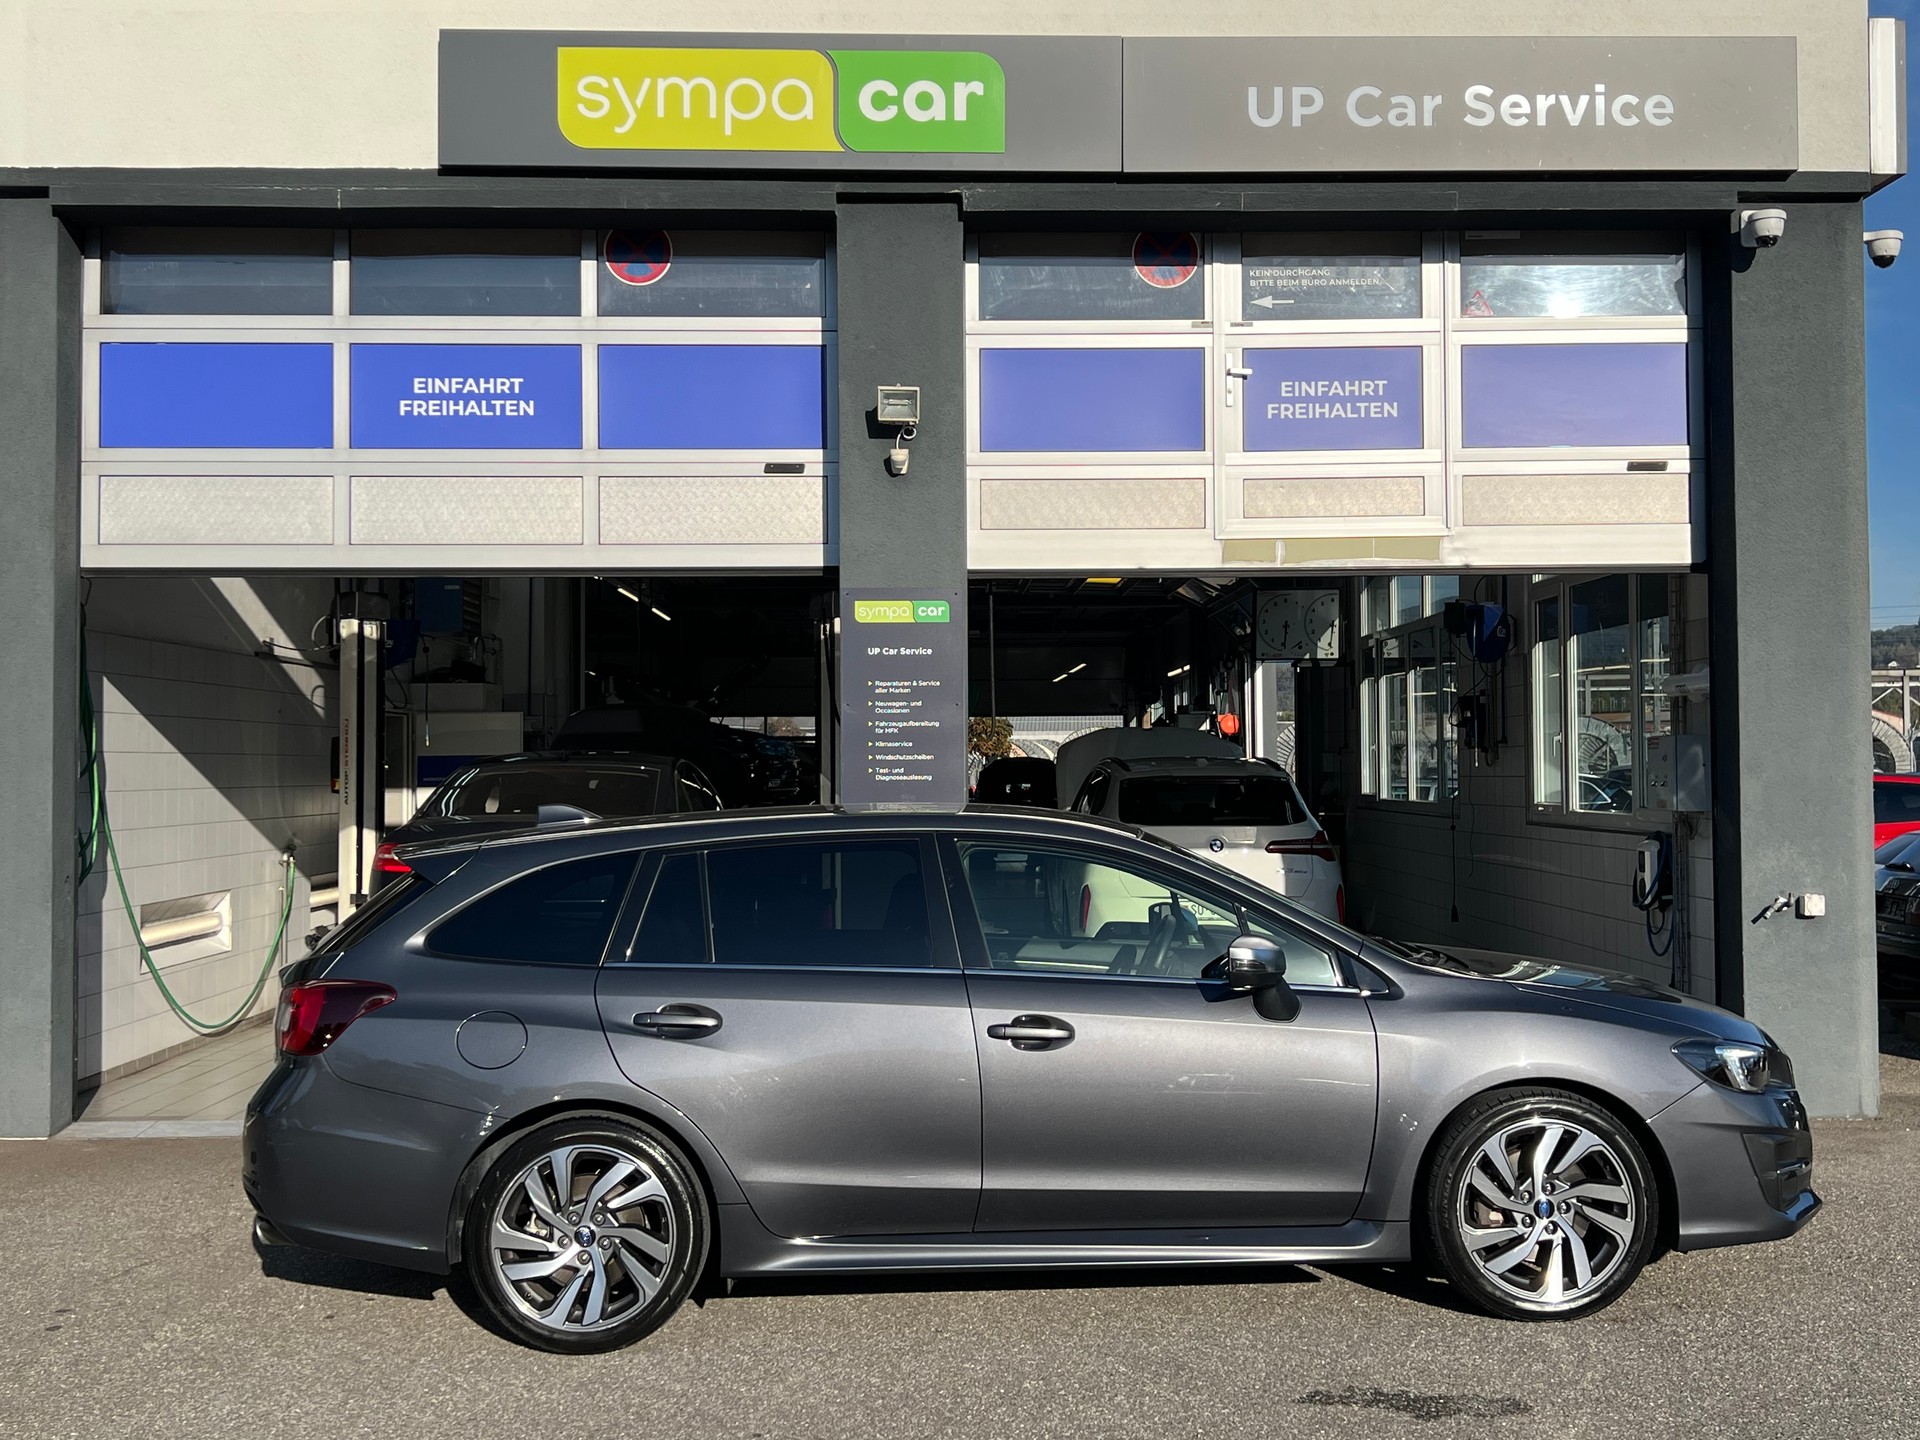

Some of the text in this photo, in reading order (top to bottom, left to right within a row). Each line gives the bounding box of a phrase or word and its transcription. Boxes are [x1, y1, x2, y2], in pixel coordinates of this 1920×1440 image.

[576, 74, 983, 135] sympa car
[1246, 83, 1675, 128] UP Car Service
[1273, 268, 1330, 277] DURCHGANG
[413, 378, 524, 394] EINFAHRT
[1280, 380, 1388, 397] EINFAHRT
[399, 400, 535, 416] FREIHALTEN
[1267, 402, 1398, 419] FREIHALTEN
[859, 606, 945, 620] sympa car
[868, 647, 933, 655] UP Car Service
